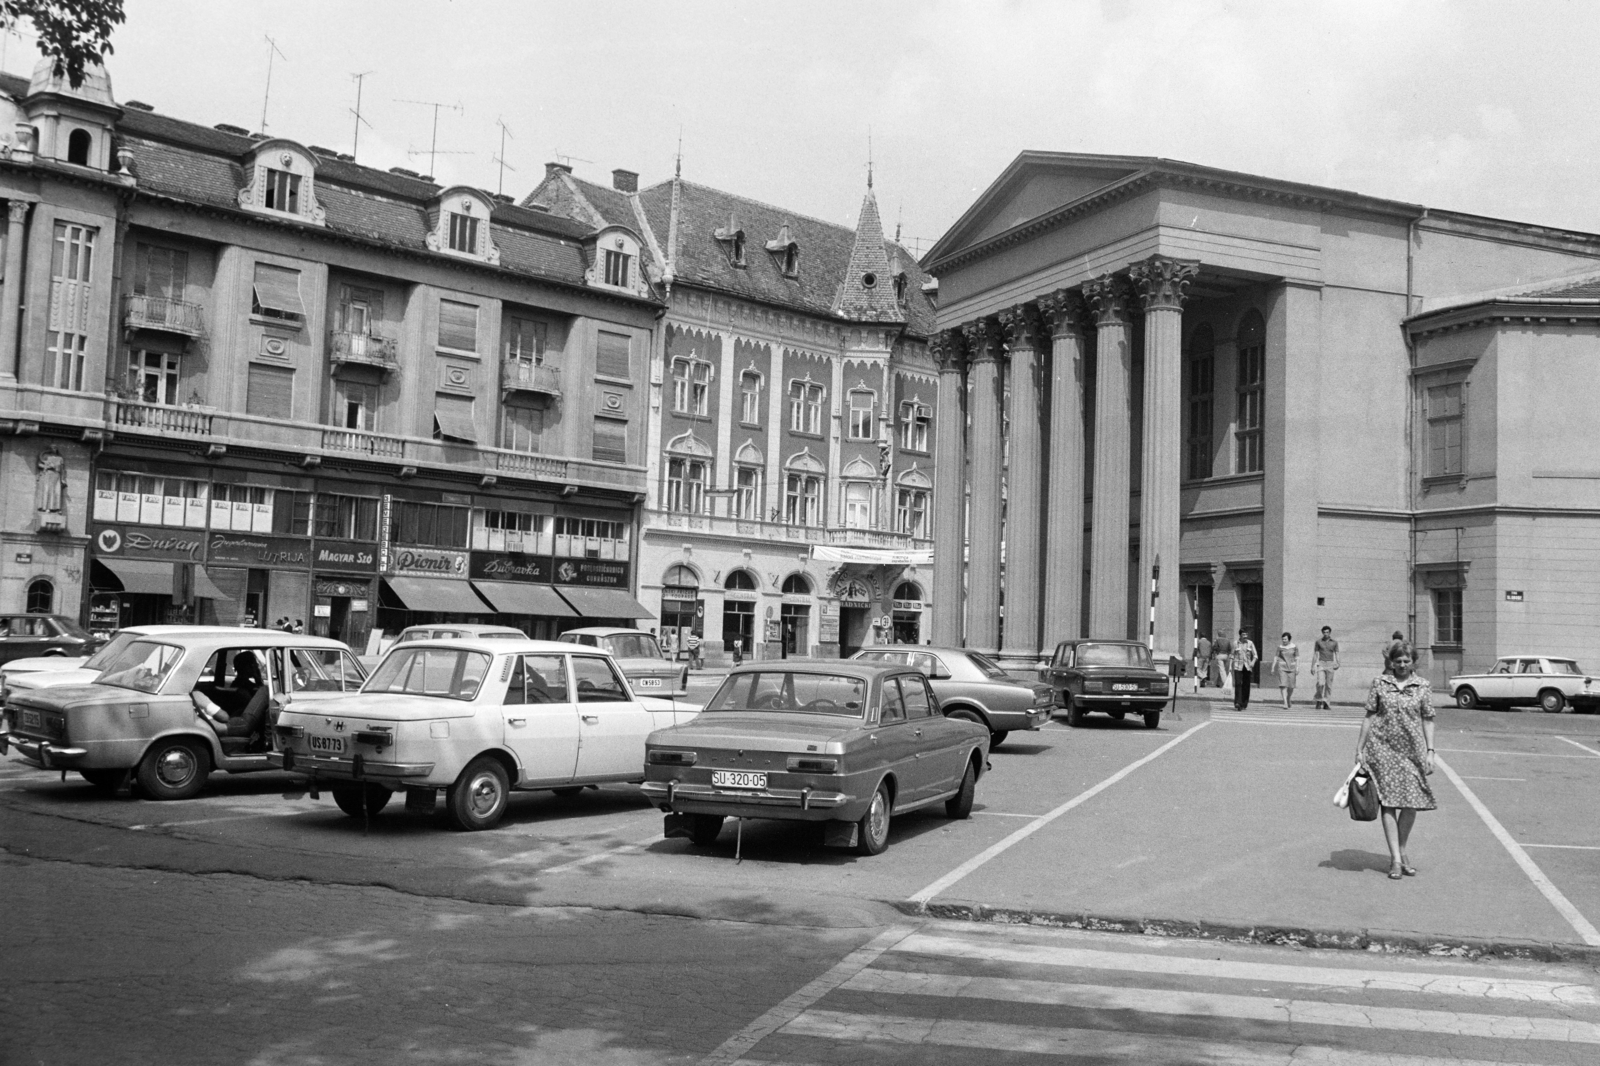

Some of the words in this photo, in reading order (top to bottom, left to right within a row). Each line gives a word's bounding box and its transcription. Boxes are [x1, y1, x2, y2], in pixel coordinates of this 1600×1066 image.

[124, 532, 199, 561] Duvan
[257, 551, 305, 562] LUTRIJA
[318, 550, 354, 563] MAGYAR
[356, 552, 373, 564] SZÓ
[397, 551, 452, 571] Pionir
[483, 560, 540, 576] Dubravka
[833, 572, 848, 598] KINO
[336, 721, 344, 731] H
[713, 771, 766, 787] SU-320-05
